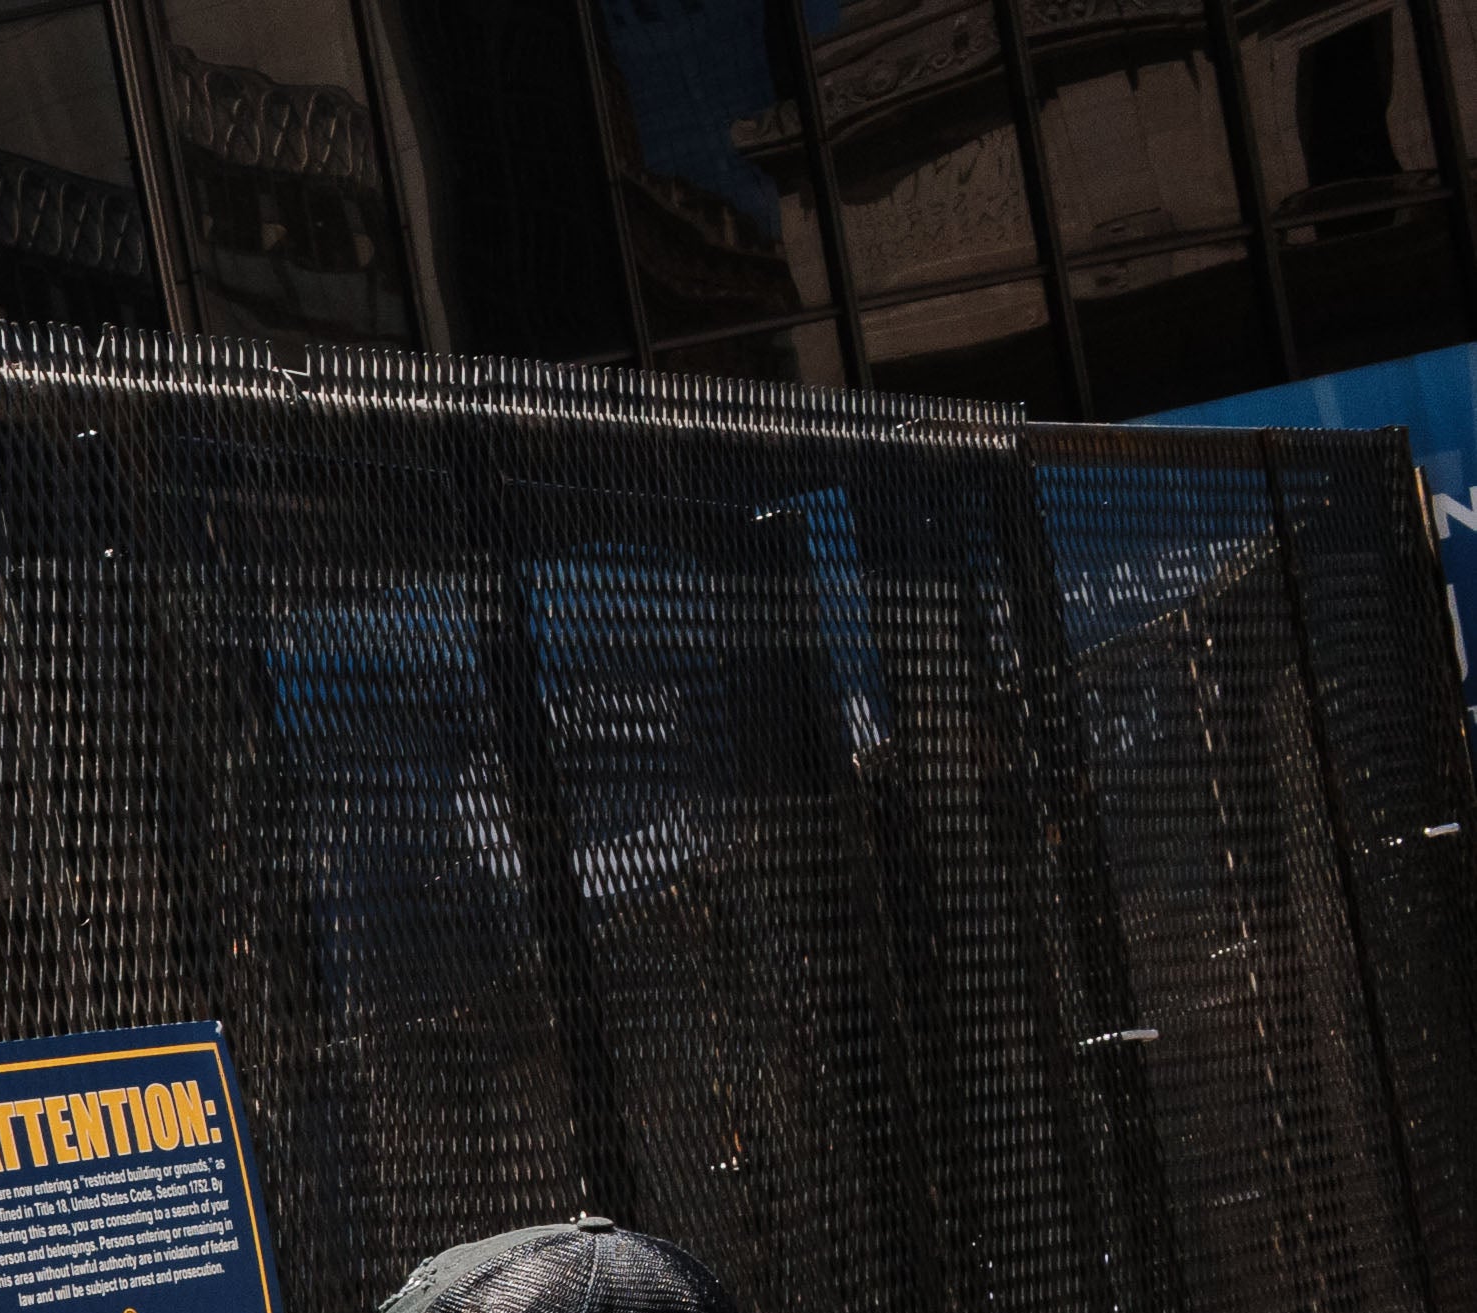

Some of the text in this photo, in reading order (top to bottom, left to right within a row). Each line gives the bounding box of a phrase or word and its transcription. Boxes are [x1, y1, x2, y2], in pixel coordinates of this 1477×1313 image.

[13, 1185, 32, 1197] now
[34, 1178, 72, 1195] entering
[72, 1179, 79, 1189] a
[79, 1169, 126, 1187] "restricted
[126, 1166, 162, 1181] building
[163, 1166, 172, 1176] or
[173, 1157, 212, 1178] grounds,"
[215, 1159, 225, 1169] as
[23, 1204, 34, 1218] in
[33, 1201, 55, 1216] Title
[56, 1198, 70, 1213] 18,
[70, 1194, 100, 1211] United
[100, 1192, 129, 1207] States
[129, 1187, 155, 1202] Code,
[155, 1183, 188, 1199] Section
[189, 1178, 211, 1193] 1752.
[211, 1177, 222, 1193] By
[27, 1246, 45, 1261] and
[45, 1240, 98, 1258] belongings.
[98, 1235, 135, 1249] Persons
[136, 1227, 171, 1244] entering
[172, 1227, 181, 1238] or
[183, 1220, 224, 1236] remaining
[224, 1217, 233, 1230] in
[28, 1224, 46, 1239] this
[47, 1223, 70, 1236] area,
[71, 1221, 89, 1236] you
[90, 1218, 104, 1230] are
[106, 1209, 153, 1227] consenting
[153, 1208, 163, 1220] to
[164, 1208, 170, 1218] a
[171, 1201, 200, 1217] search
[201, 1199, 210, 1213] of
[210, 1199, 229, 1215] your
[14, 1272, 34, 1285] area
[35, 1264, 70, 1281] without
[70, 1259, 98, 1276] lawful
[98, 1254, 136, 1271] authority
[138, 1253, 152, 1265] are
[153, 1249, 162, 1262] in
[163, 1244, 199, 1260] violation
[200, 1241, 209, 1255] of
[210, 1237, 239, 1253] federal
[18, 1262, 224, 1306] law and will be subject to arrest and prosecution.
